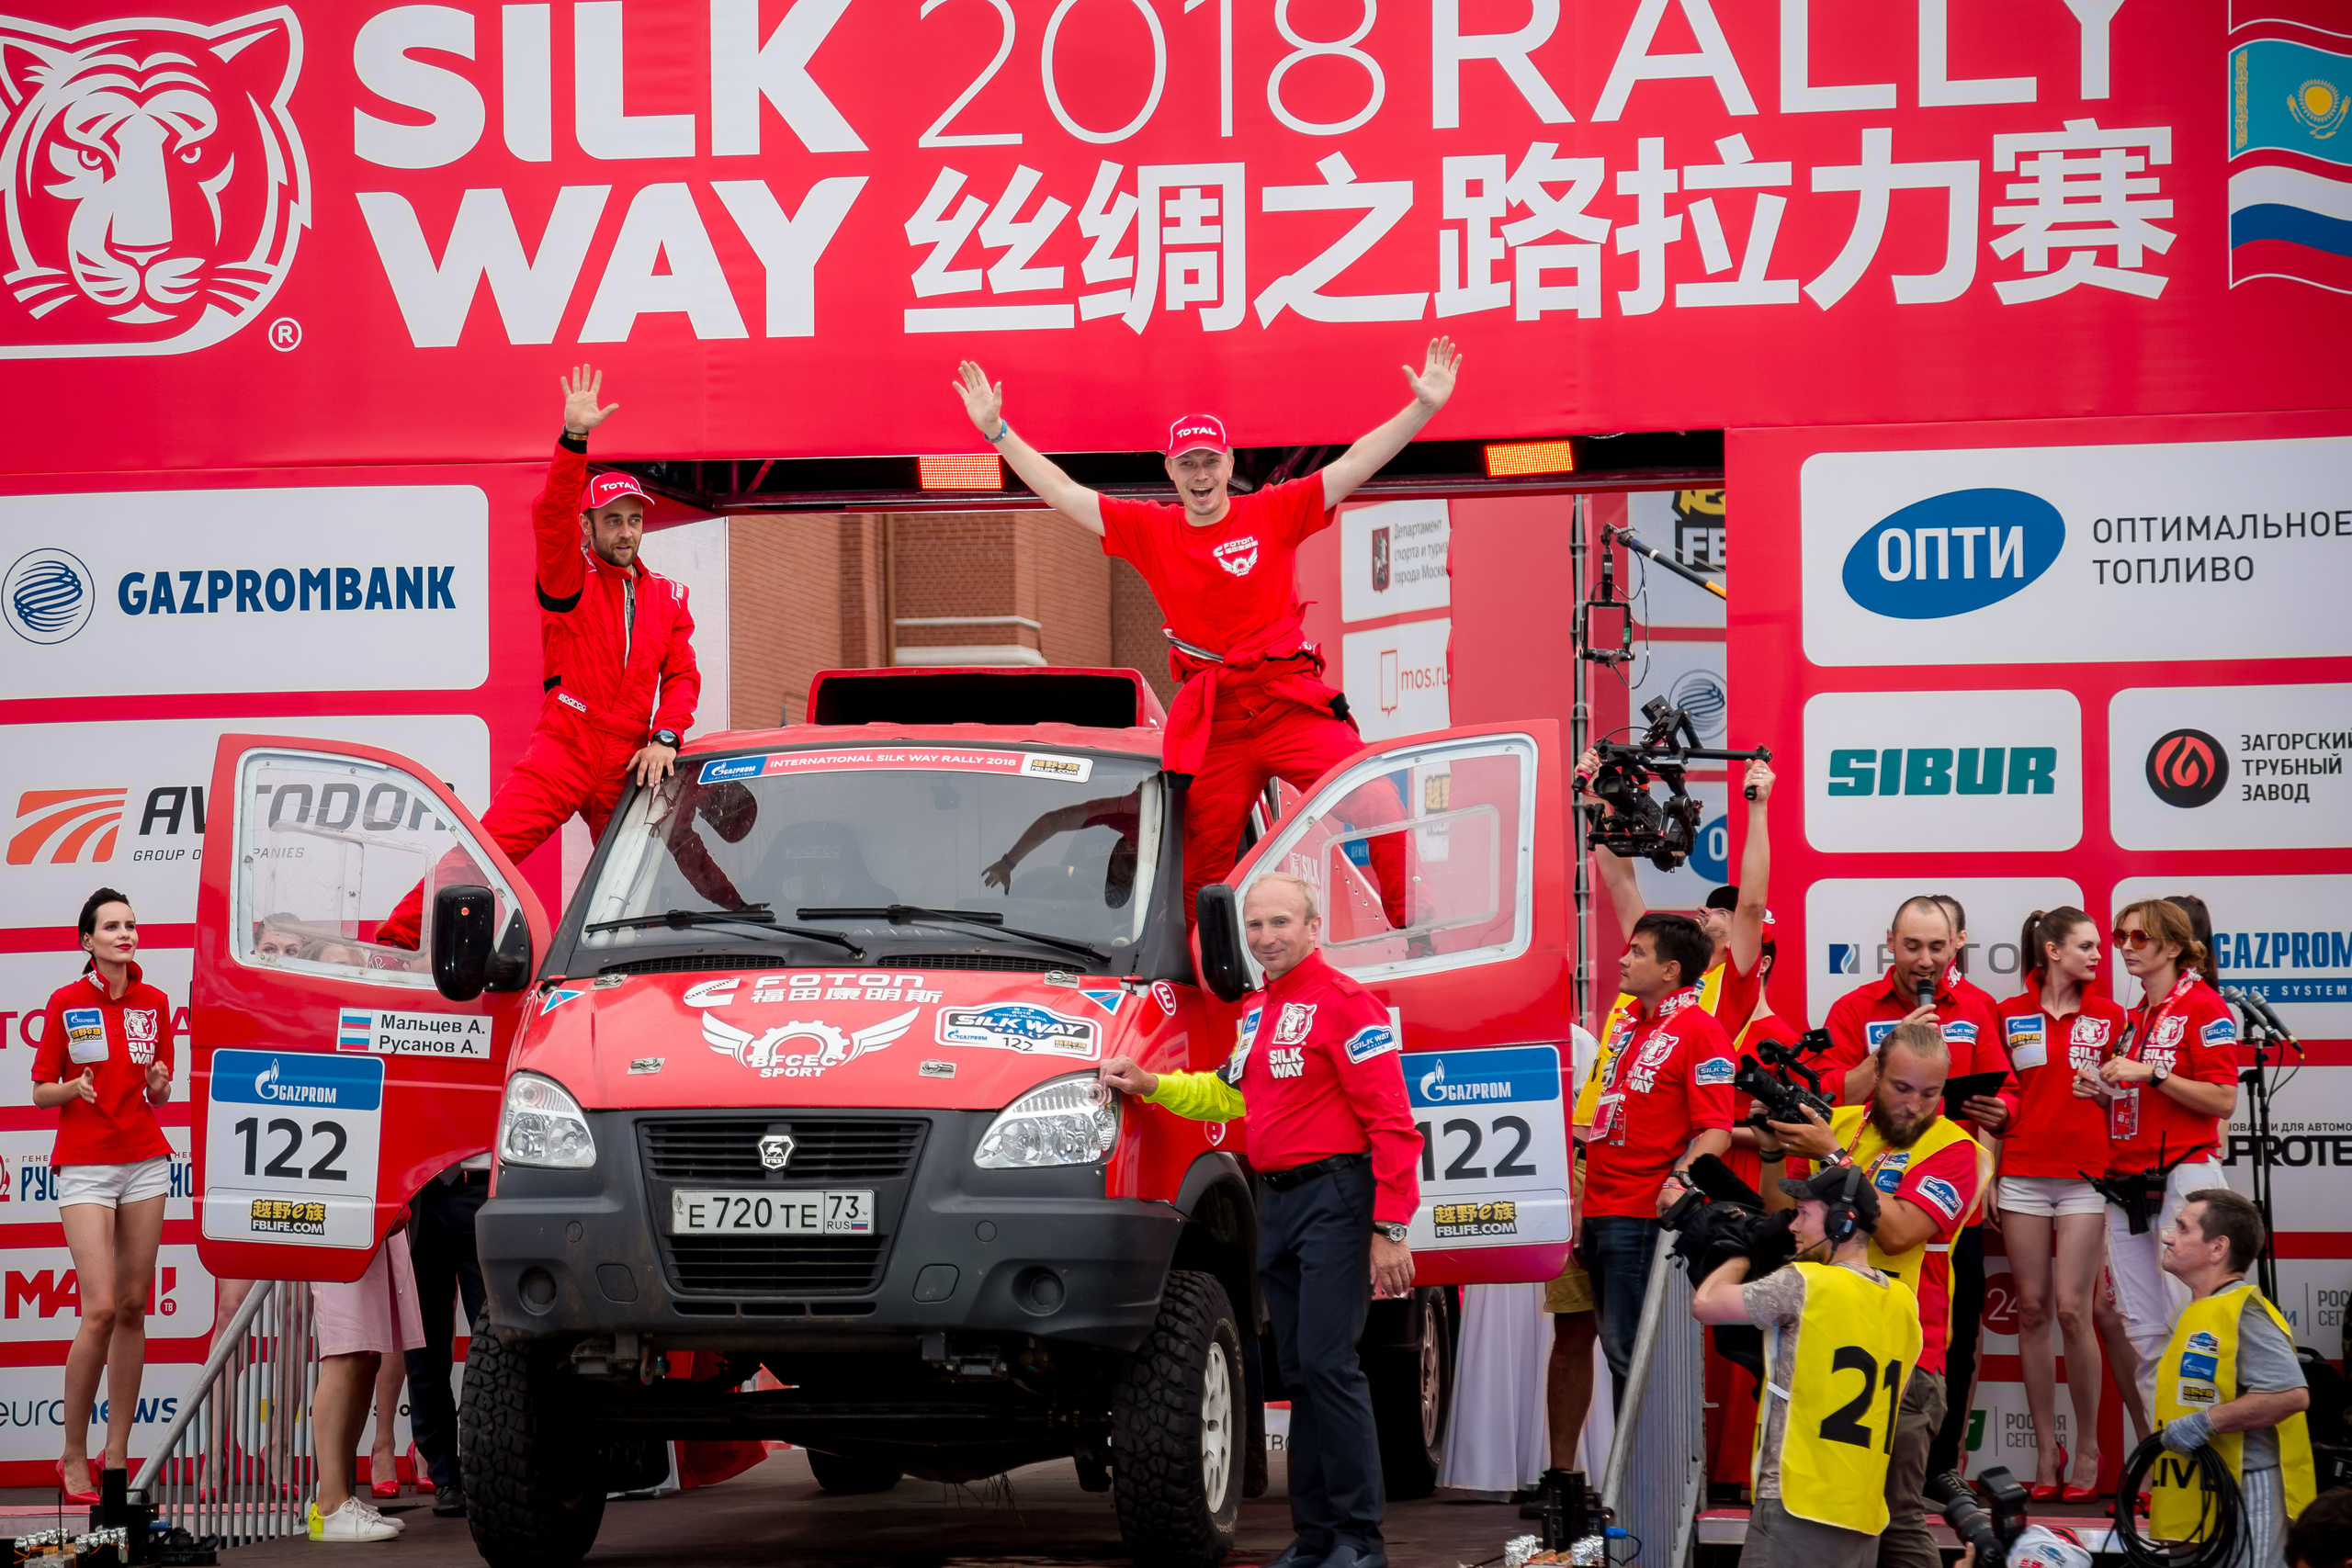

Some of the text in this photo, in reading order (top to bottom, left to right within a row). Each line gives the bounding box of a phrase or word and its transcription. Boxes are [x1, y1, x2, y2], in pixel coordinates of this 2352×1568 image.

[919, 0, 2126, 149] 2018 RALLY
[354, 0, 871, 170] SILK
[904, 118, 2177, 336] 丝绸之路拉力赛
[355, 179, 871, 349] WAY
[1176, 426, 1217, 438] TOTAL
[600, 481, 639, 492] TOTAL
[2092, 510, 2352, 544] ОПТИМАЛЬНОЕ
[1878, 525, 2025, 582] ОПТИ
[2092, 555, 2255, 585] ТОПЛИВО
[118, 565, 457, 615] GAZPROMBANK
[1401, 666, 1449, 692] mos.ru
[723, 765, 757, 775] GAZPROM
[770, 754, 1017, 768] INTERNATIONAL SILK WAY RALLY 2018
[2241, 754, 2343, 778] ТРУБНЫЙ
[1827, 746, 2057, 797] SIBUR
[2242, 783, 2311, 804] ЗАВОД
[133, 850, 186, 862] GROUP
[755, 974, 925, 988] FOTON
[751, 988, 944, 1004] 福田康明斯
[2281, 986, 2352, 996] SYSTEM
[380, 1014, 486, 1034] Мальцев А.
[955, 1015, 1085, 1035] SILK WAY
[994, 1027, 1046, 1039] RALLY
[379, 1035, 479, 1055] Русанов А.
[1002, 1037, 1034, 1052] 122
[1352, 1032, 1390, 1052] SILK WAY
[751, 1055, 840, 1067] BFCEC
[1269, 1047, 1305, 1065] SILK
[2069, 1046, 2101, 1062] SILK
[2143, 1049, 2177, 1062] SILK
[760, 1067, 825, 1078] SPORT
[1270, 1061, 1305, 1079] WAY
[1634, 1066, 1657, 1083] ILK
[278, 1085, 337, 1104] GAZPROM
[1448, 1081, 1511, 1101] GAZPROM
[2281, 1122, 2304, 1133] ДЛЯ
[234, 1117, 348, 1181] 122
[1415, 1115, 1537, 1181] 122
[829, 1195, 859, 1219] 73
[252, 1219, 323, 1235] FBLIFE.COM
[827, 1221, 850, 1230] RUS
[1436, 1222, 1516, 1237] FBLIFE.COM
[1820, 1346, 1903, 1456] 21
